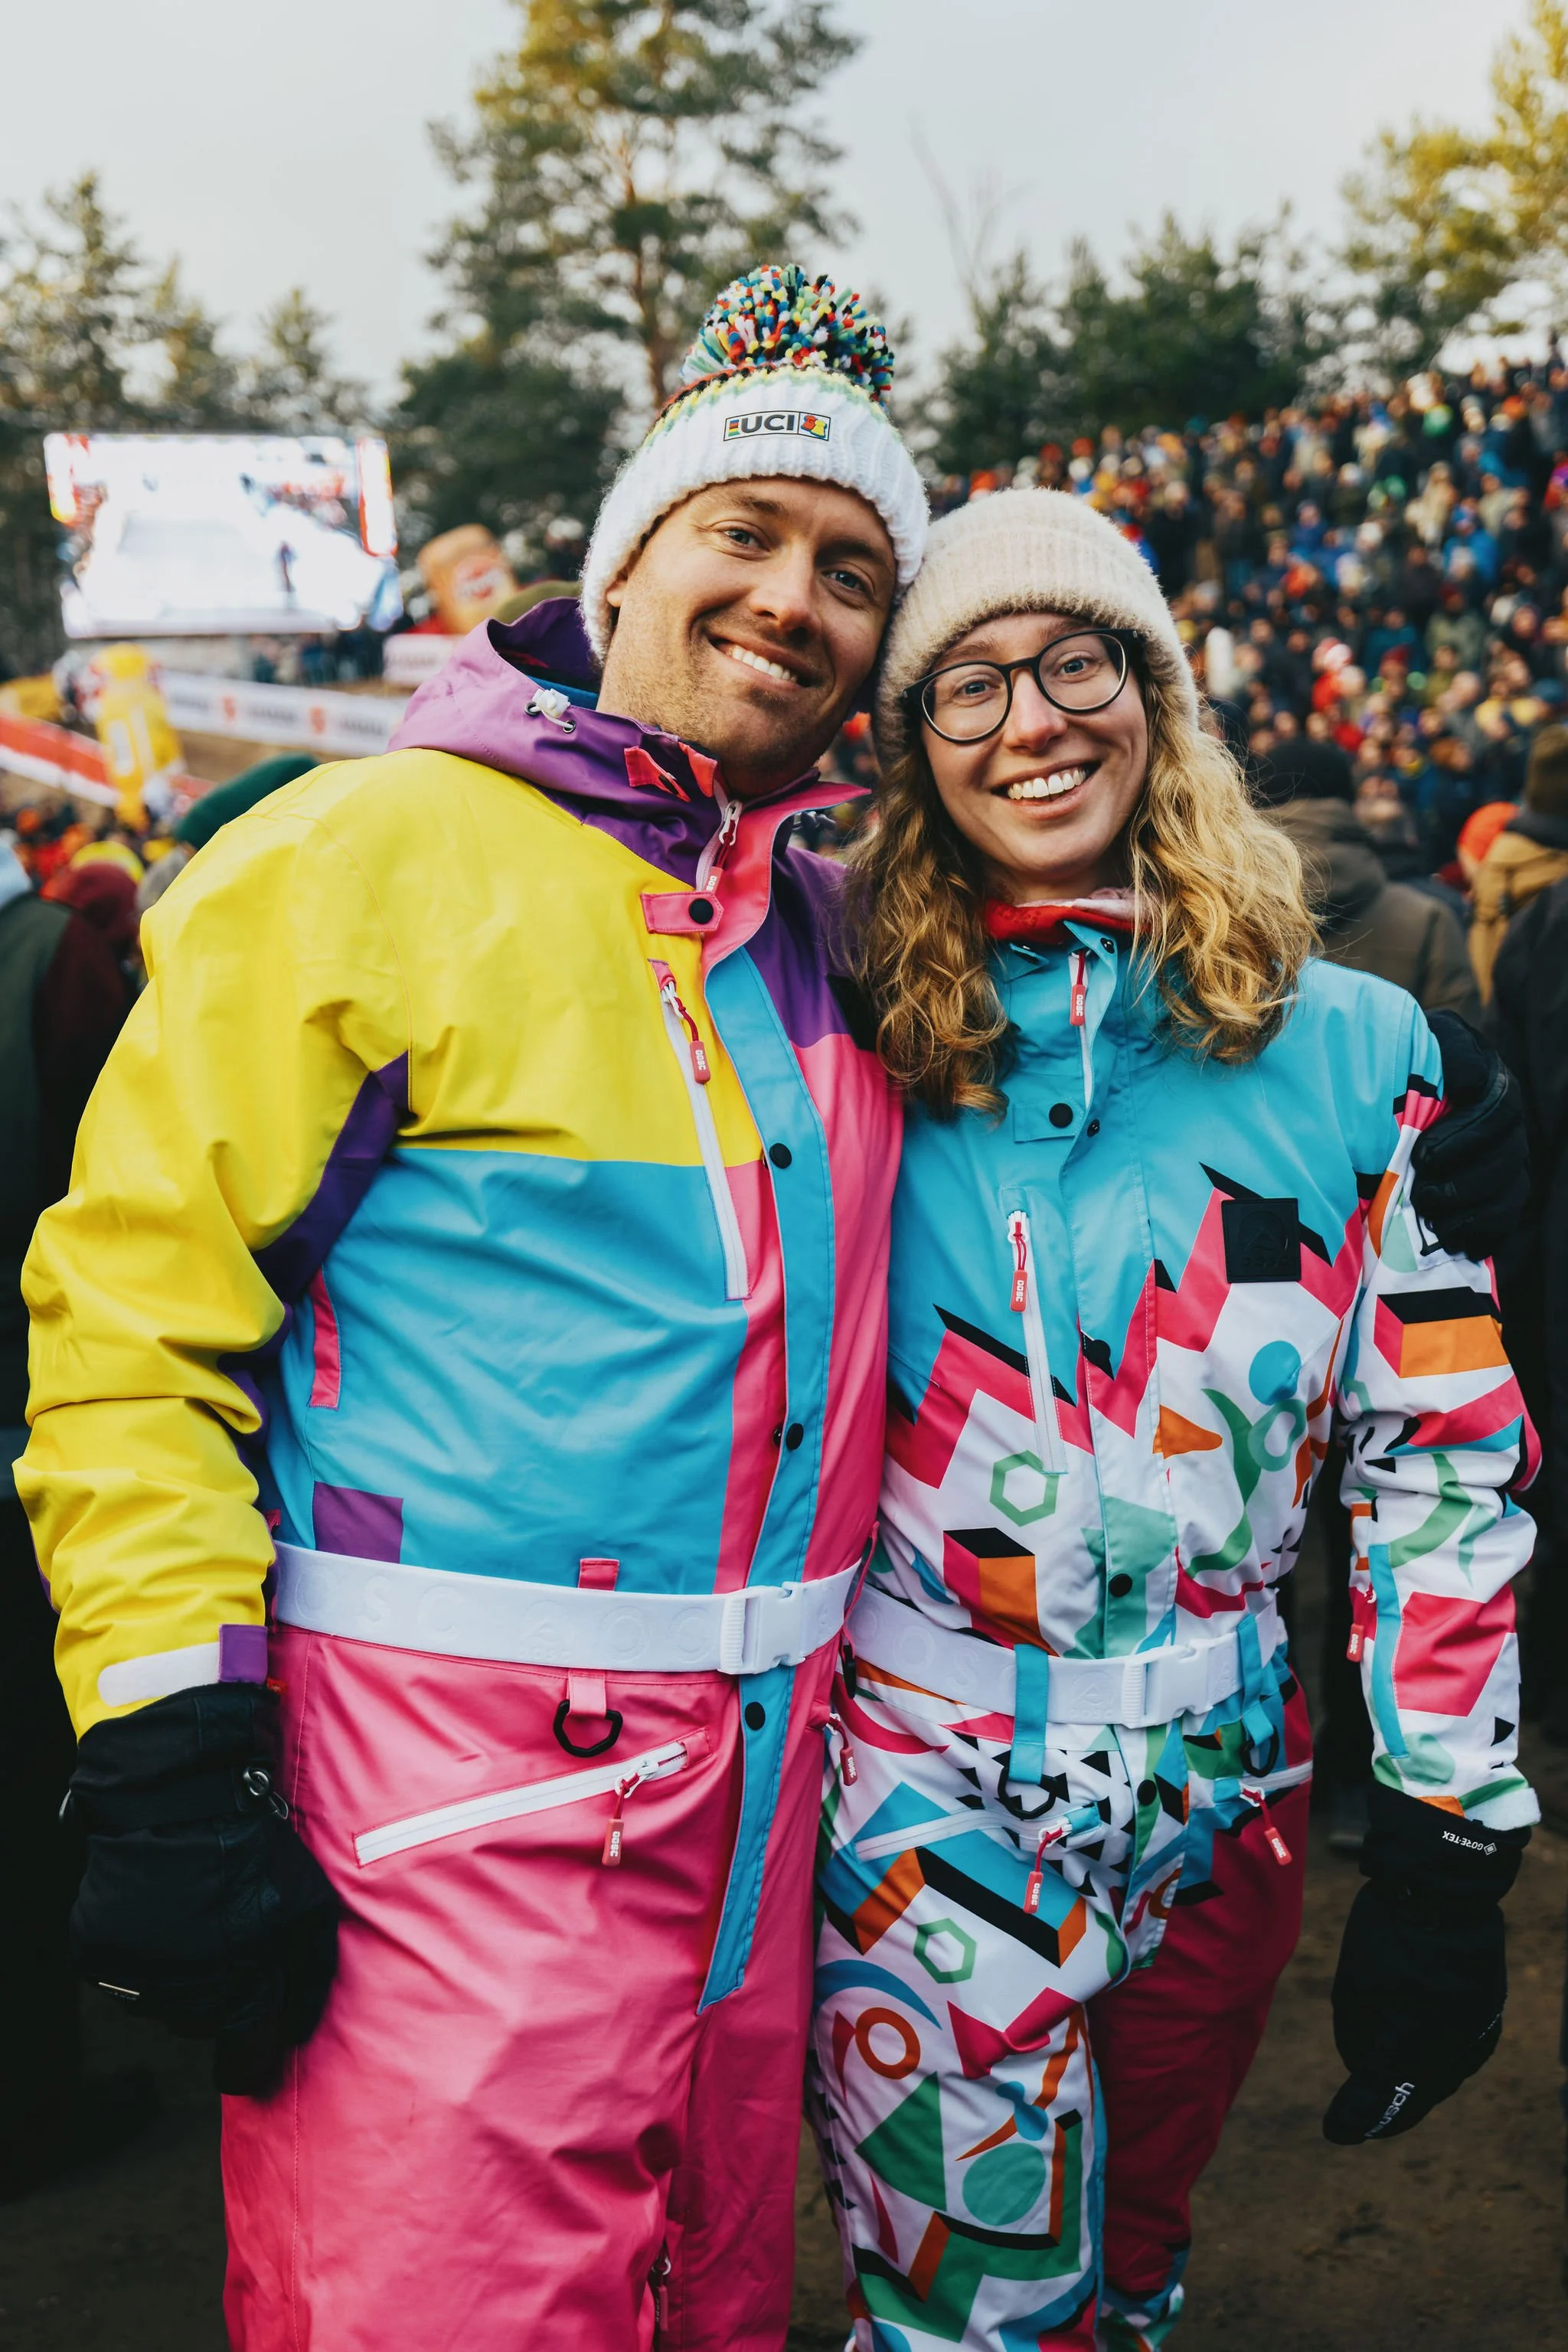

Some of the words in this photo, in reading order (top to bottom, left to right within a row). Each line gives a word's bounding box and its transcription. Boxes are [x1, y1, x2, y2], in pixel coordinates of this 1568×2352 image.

[740, 414, 795, 433] UCI
[706, 875, 717, 891] OOS
[1015, 1279, 1024, 1302] OOSC
[1442, 1831, 1484, 1851] GORE-TEX
